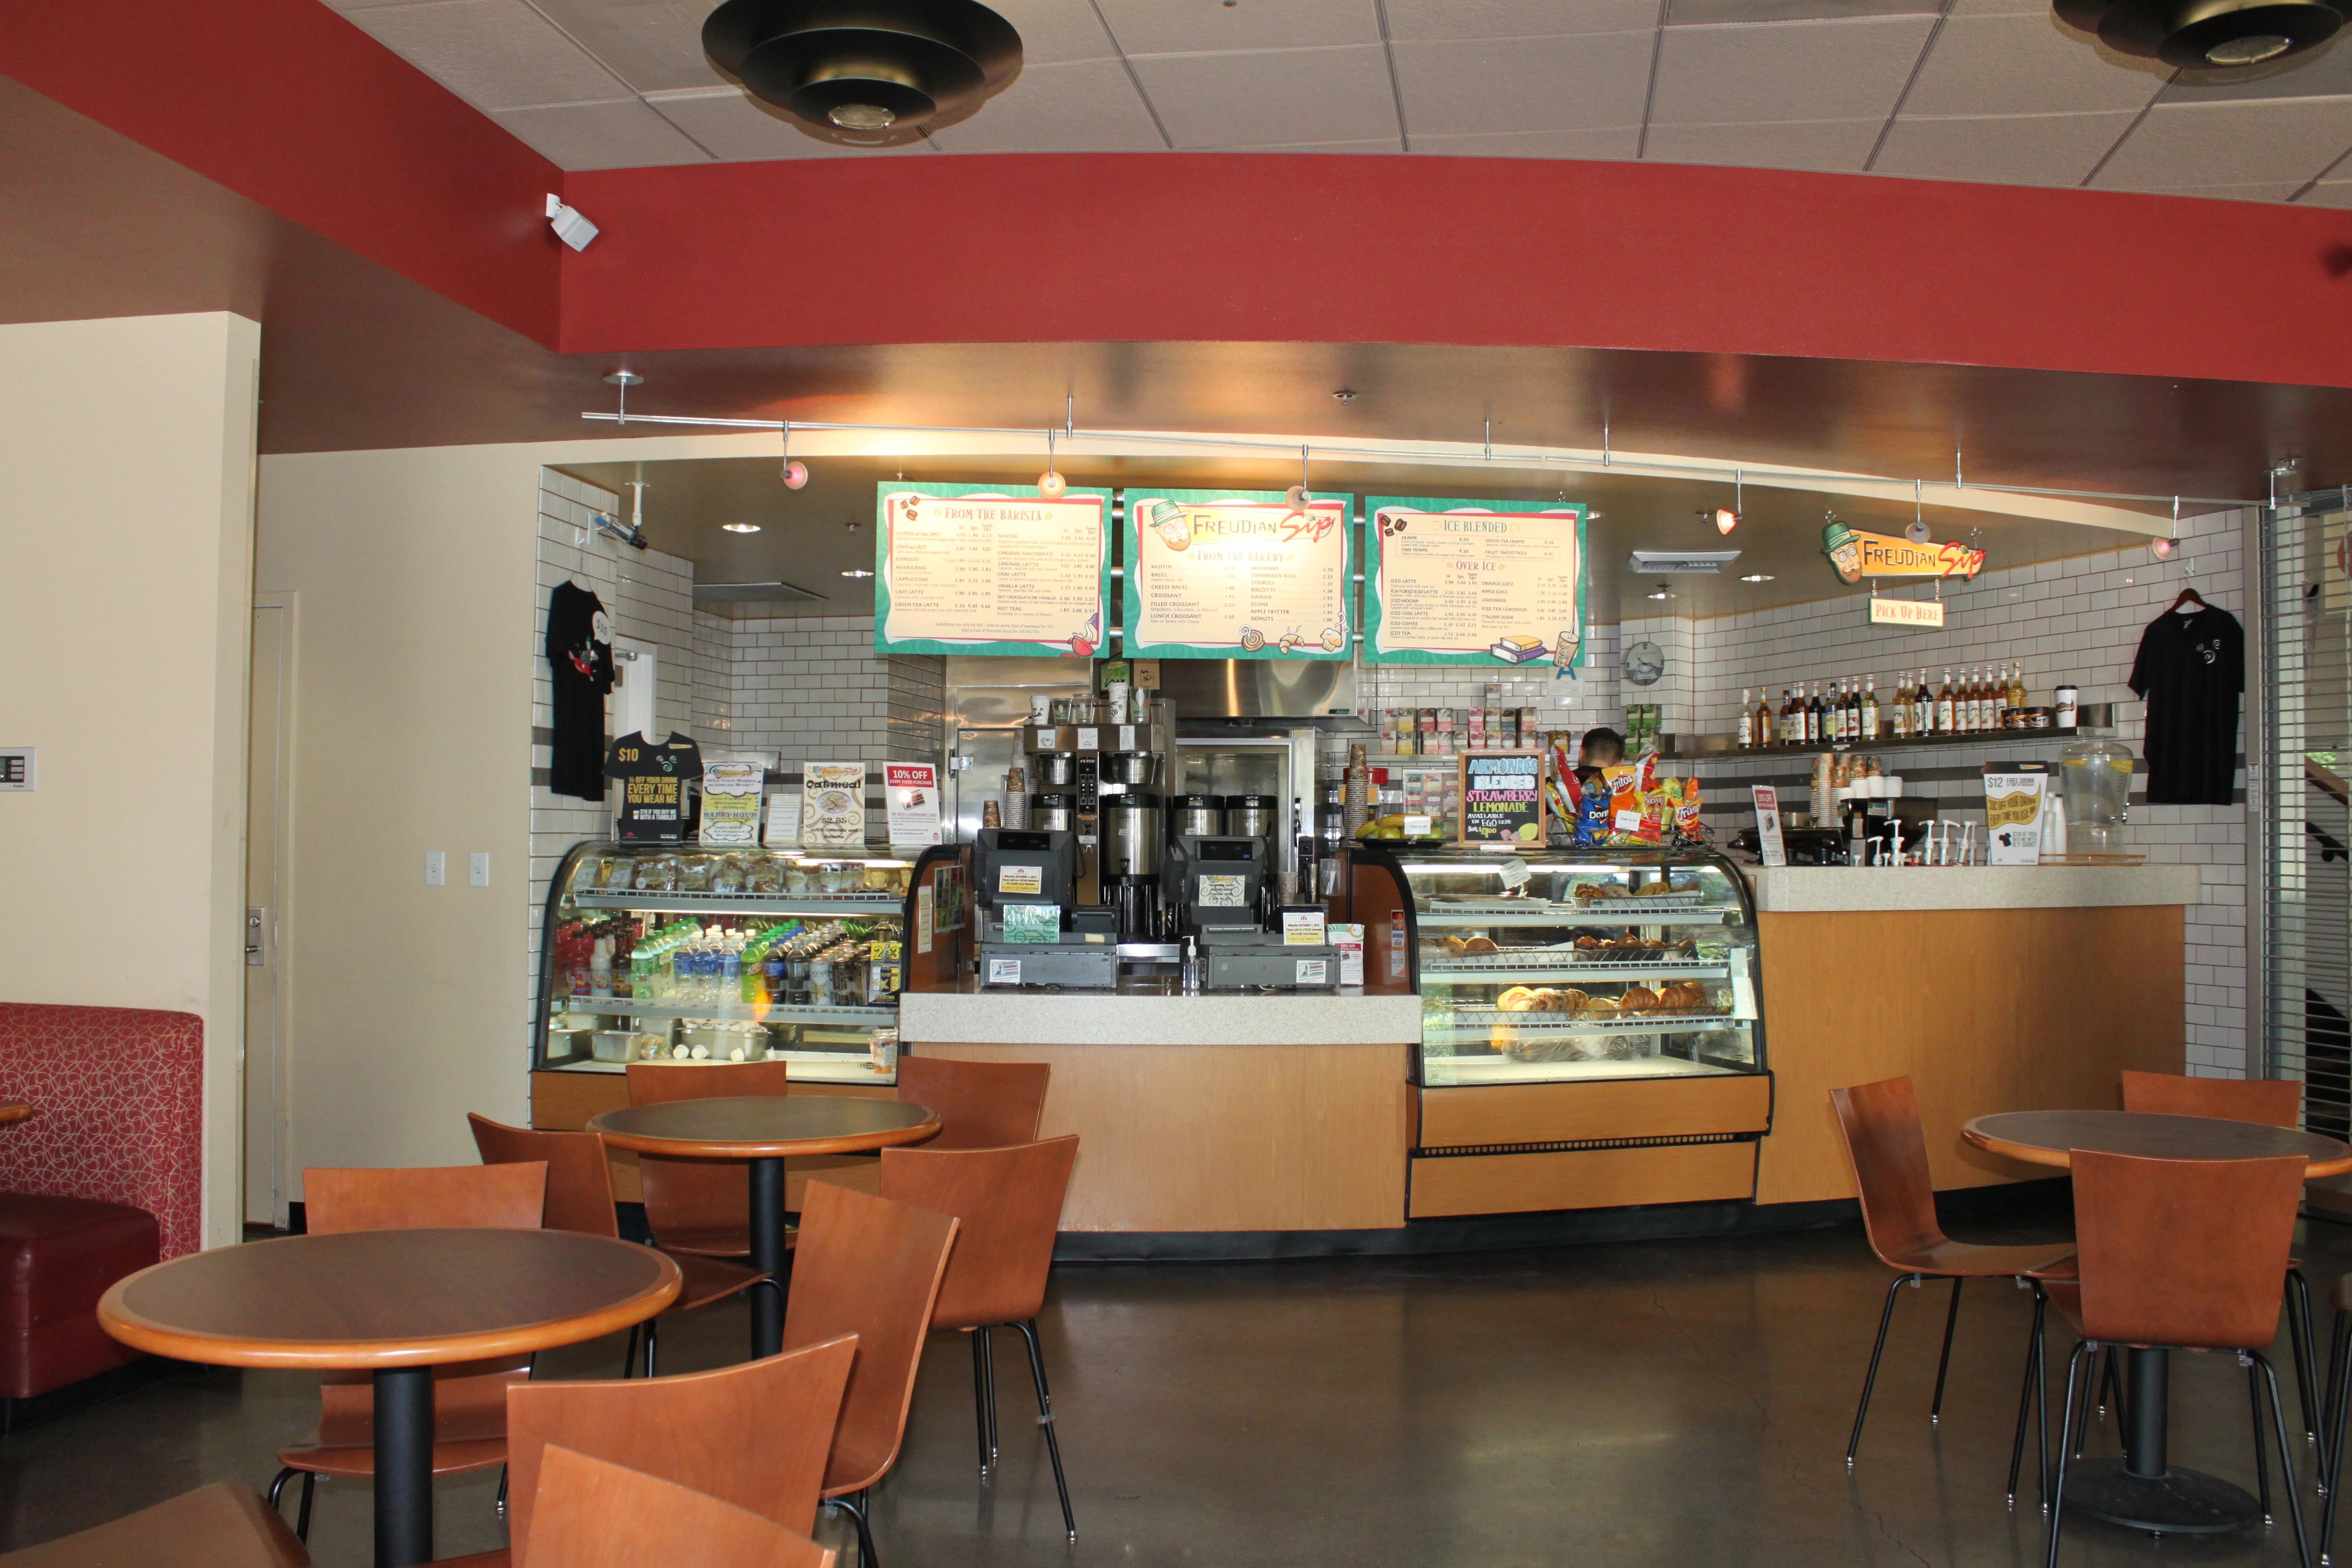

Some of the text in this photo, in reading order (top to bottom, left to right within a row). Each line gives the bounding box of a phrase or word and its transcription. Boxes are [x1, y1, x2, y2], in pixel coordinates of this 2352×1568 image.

[945, 508, 1041, 521] FROM THE BARISTA
[1444, 520, 1507, 533] ICE BLENDED
[1198, 550, 1223, 561] FROM
[1248, 552, 1284, 562] BAKERY
[1938, 540, 1986, 579] Sip
[1456, 560, 1496, 571] OVER ICE
[1875, 604, 1939, 621] PICK UP HERE
[619, 748, 638, 762] $10
[893, 770, 928, 779] 10% OFF
[806, 780, 861, 788] Oatmeal
[1474, 775, 1535, 790] BLENDED
[1612, 775, 1633, 789] Fritos
[1988, 777, 2003, 788] $12
[628, 784, 678, 794] EVERY TIME
[628, 794, 677, 803] YOU WEAR ME
[1467, 790, 1537, 802] STRAWBERRY
[1473, 802, 1529, 812] LEMONADE
